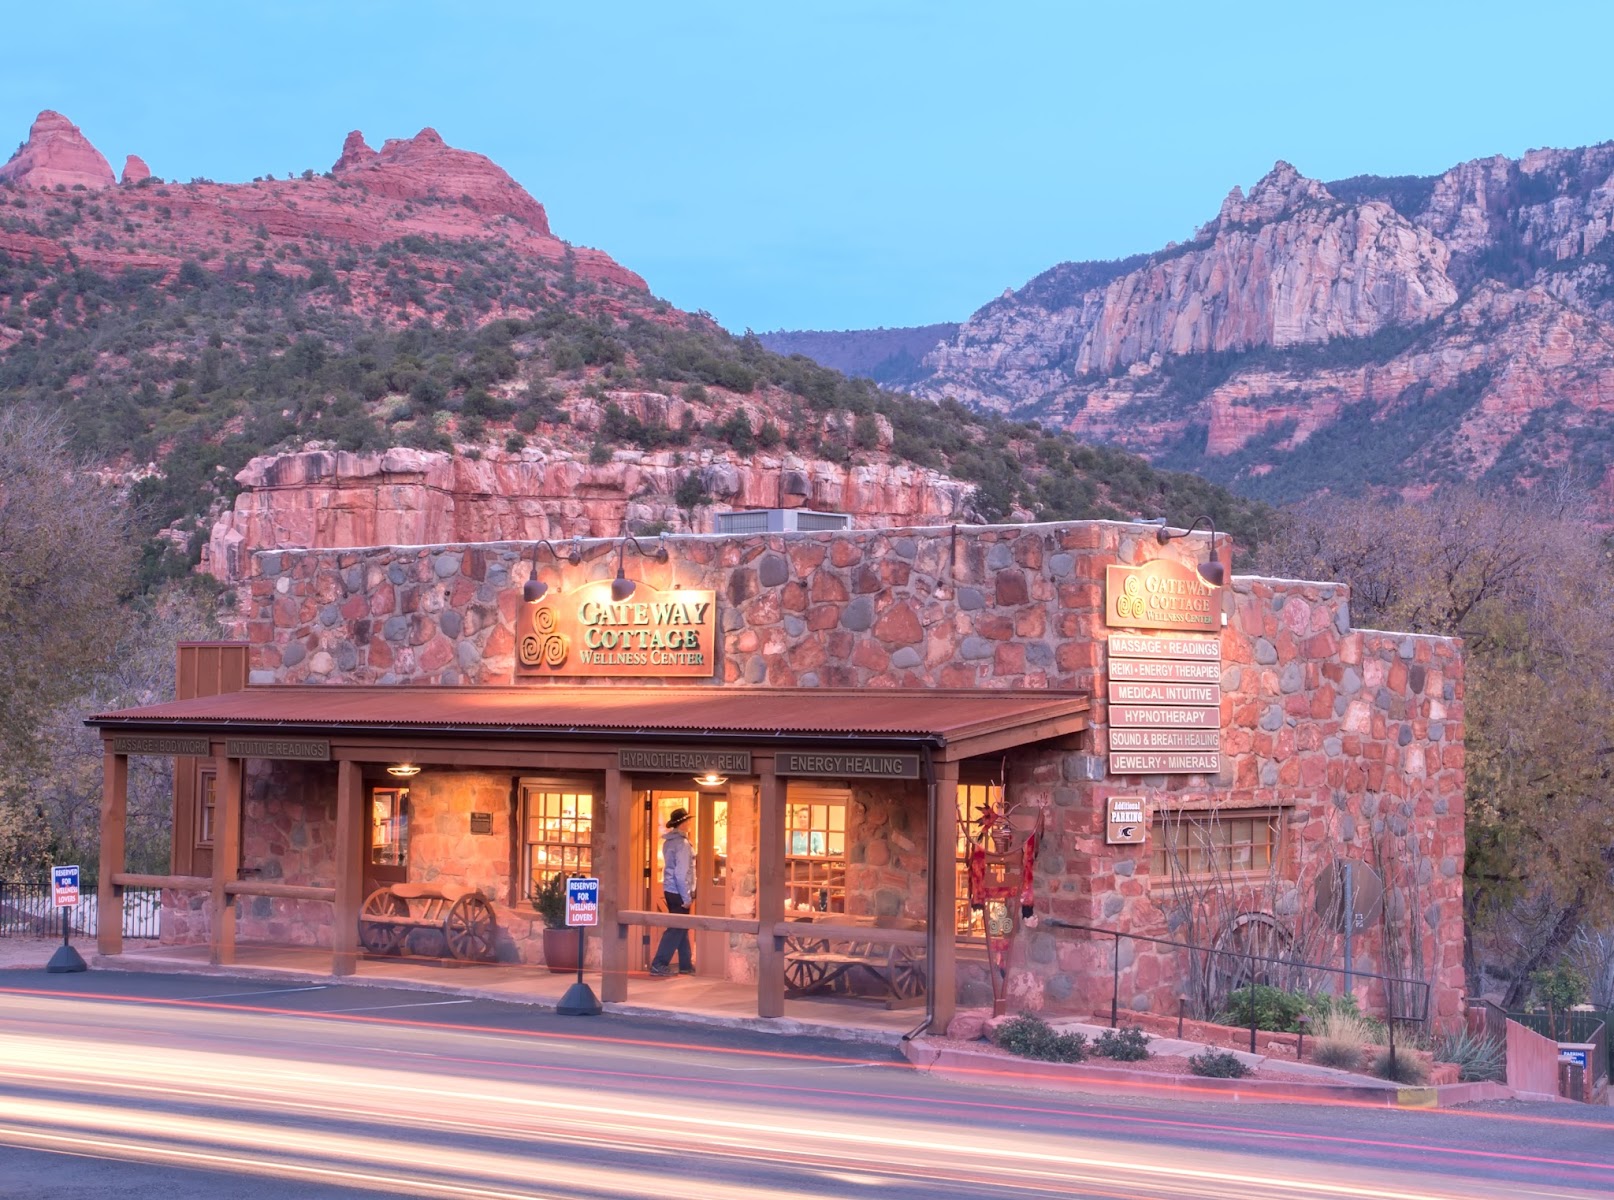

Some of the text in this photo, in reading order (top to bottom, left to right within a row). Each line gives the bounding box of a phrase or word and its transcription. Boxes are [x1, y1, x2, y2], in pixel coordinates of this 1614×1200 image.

[1149, 594, 1210, 612] COTTAGE
[578, 602, 709, 626] GATEWAY
[1146, 610, 1213, 625] WELLNESS CENTER
[585, 628, 698, 649] COTTAGE
[1112, 639, 1218, 656] MASSAGE READINGS
[580, 650, 704, 665] WELLNESS CENTER
[1111, 662, 1219, 678] REIKI ENERGY THERAPIES
[1118, 686, 1212, 700] MEDICAL INTUITIVE
[1124, 710, 1206, 723] HYPNOTHERAPY
[114, 738, 207, 754] MASSAGE BODYWORK
[1112, 733, 1219, 748] SOUND & BREATH HEALING
[230, 743, 324, 757] INTUITIVE READINGS
[622, 752, 747, 770] HYPNOTHERAPY REIKI
[790, 756, 903, 774] ENERGY HEALING
[1114, 756, 1217, 769] JEWELRY MINERALS
[1114, 802, 1140, 810] Additional
[1111, 812, 1142, 823] PARKING
[56, 868, 78, 876] RESERVED
[577, 892, 589, 901] FOR
[570, 903, 596, 911] WELLNESS
[572, 913, 593, 922] LOVERS
